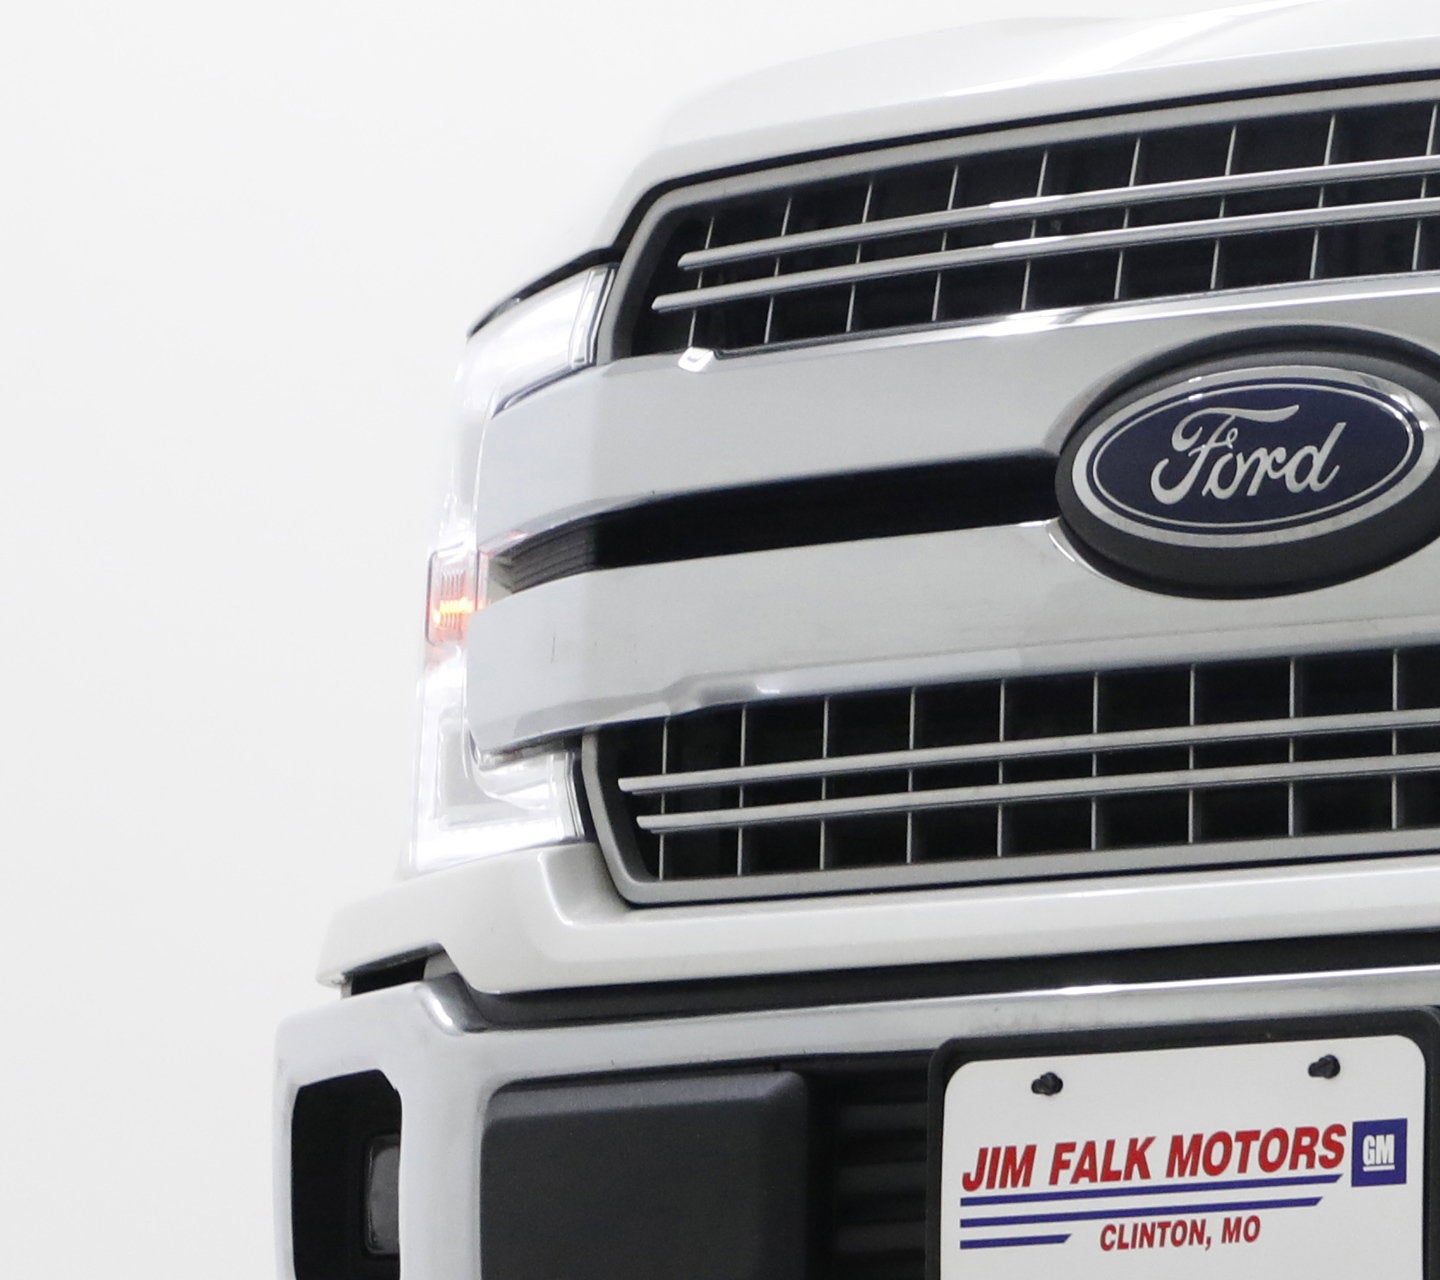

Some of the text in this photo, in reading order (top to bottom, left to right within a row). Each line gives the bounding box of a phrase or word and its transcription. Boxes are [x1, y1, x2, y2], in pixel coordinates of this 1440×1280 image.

[1150, 403, 1347, 506] Ford
[962, 1124, 1347, 1192] JIM FALK MOTORS
[1362, 1133, 1396, 1170] GM
[1100, 1215, 1261, 1252] CLINTON, MO
